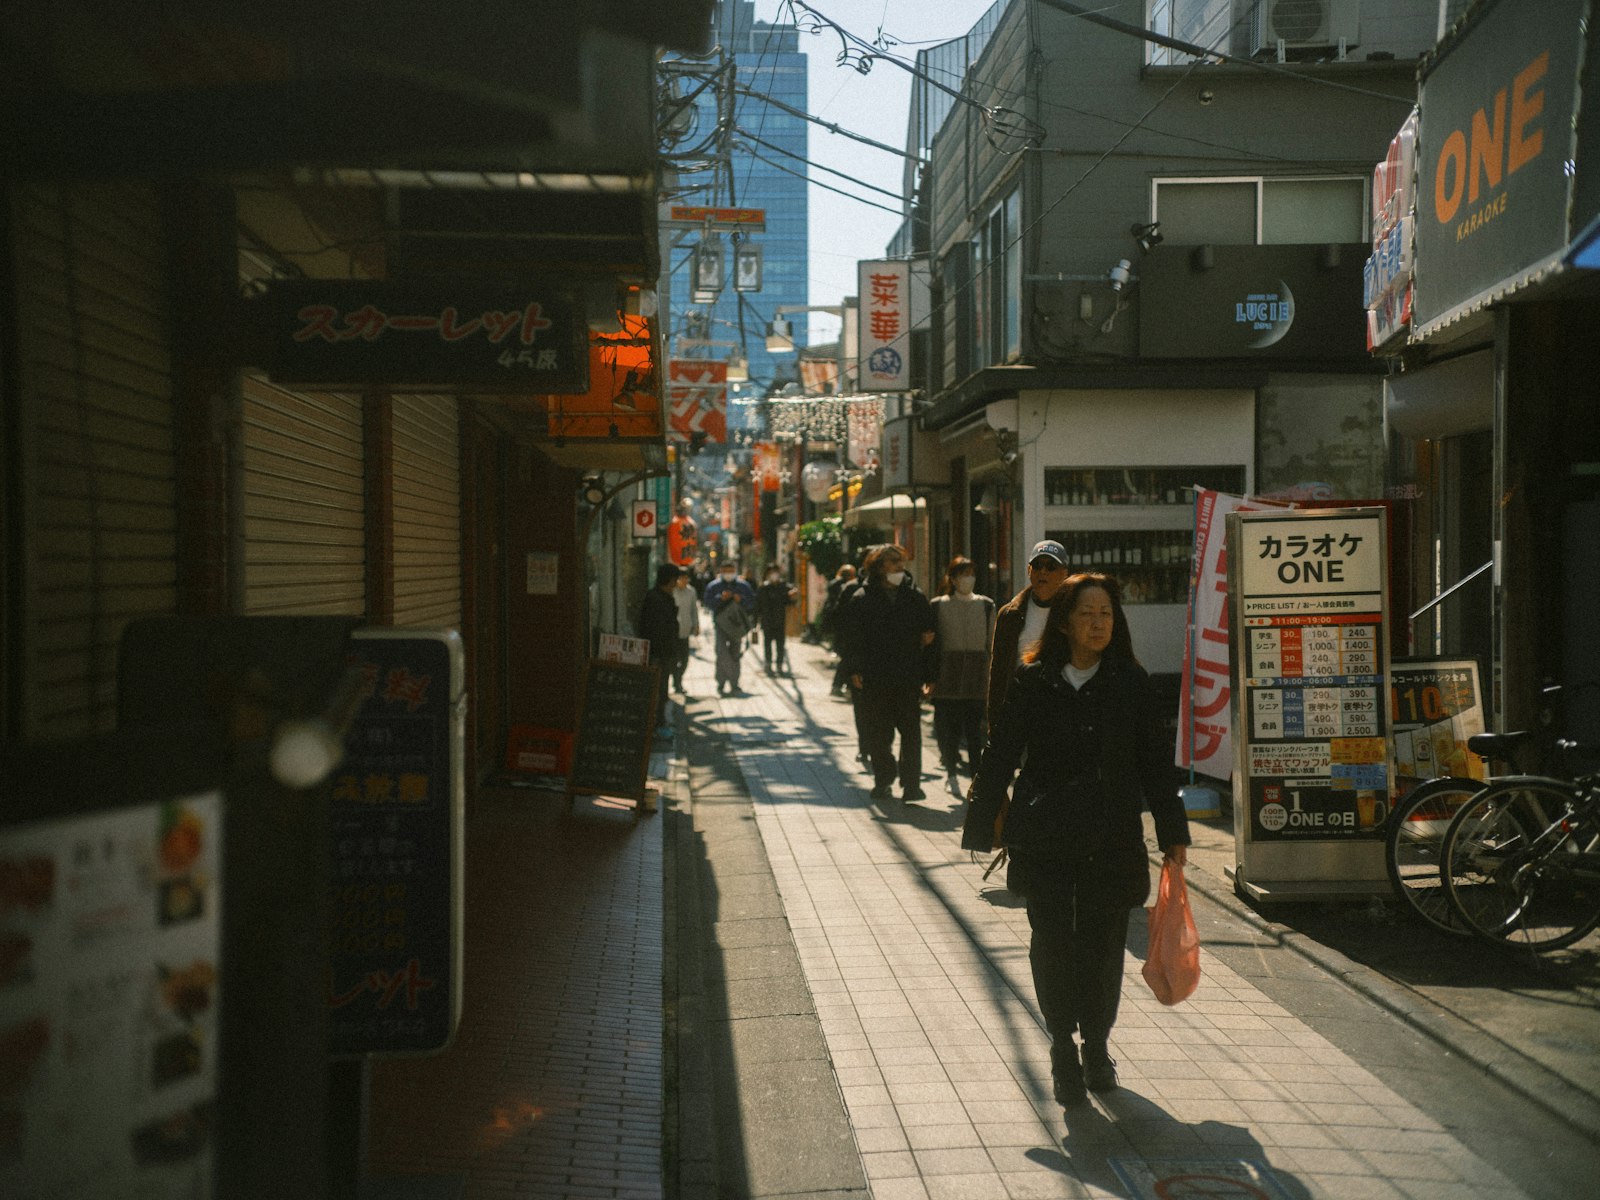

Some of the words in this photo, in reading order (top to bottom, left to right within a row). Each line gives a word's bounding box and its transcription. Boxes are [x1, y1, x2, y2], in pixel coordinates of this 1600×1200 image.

[1435, 48, 1550, 224] ONE
[1456, 192, 1508, 243] KARAOKE
[1235, 301, 1289, 322] LUCIE
[292, 302, 552, 345] スカーレット
[1200, 497, 1213, 529] WHITE
[1259, 533, 1363, 559] カラオケ
[1277, 560, 1345, 584] ONE
[1252, 603, 1276, 611] PRICE
[1277, 602, 1294, 610] LIST
[1349, 628, 1367, 637] 240
[1256, 642, 1277, 650] シニア
[1309, 642, 1335, 651] 1,000
[1345, 641, 1370, 649] 1,400
[1259, 662, 1275, 670] 会員
[1312, 654, 1330, 662] 240
[1349, 653, 1367, 661] 290
[1309, 666, 1335, 675] 1,400
[1346, 665, 1372, 673] 1,800
[1313, 691, 1332, 699] 290
[1349, 689, 1368, 697] 390
[1261, 722, 1277, 730] 会員
[1314, 715, 1333, 723] 490
[1349, 714, 1368, 722] 590
[1311, 727, 1337, 735] 1,900
[1347, 726, 1373, 735] 2,500
[1290, 791, 1303, 813] 1
[1289, 812, 1324, 827] ONE
[1328, 812, 1355, 827] の日
